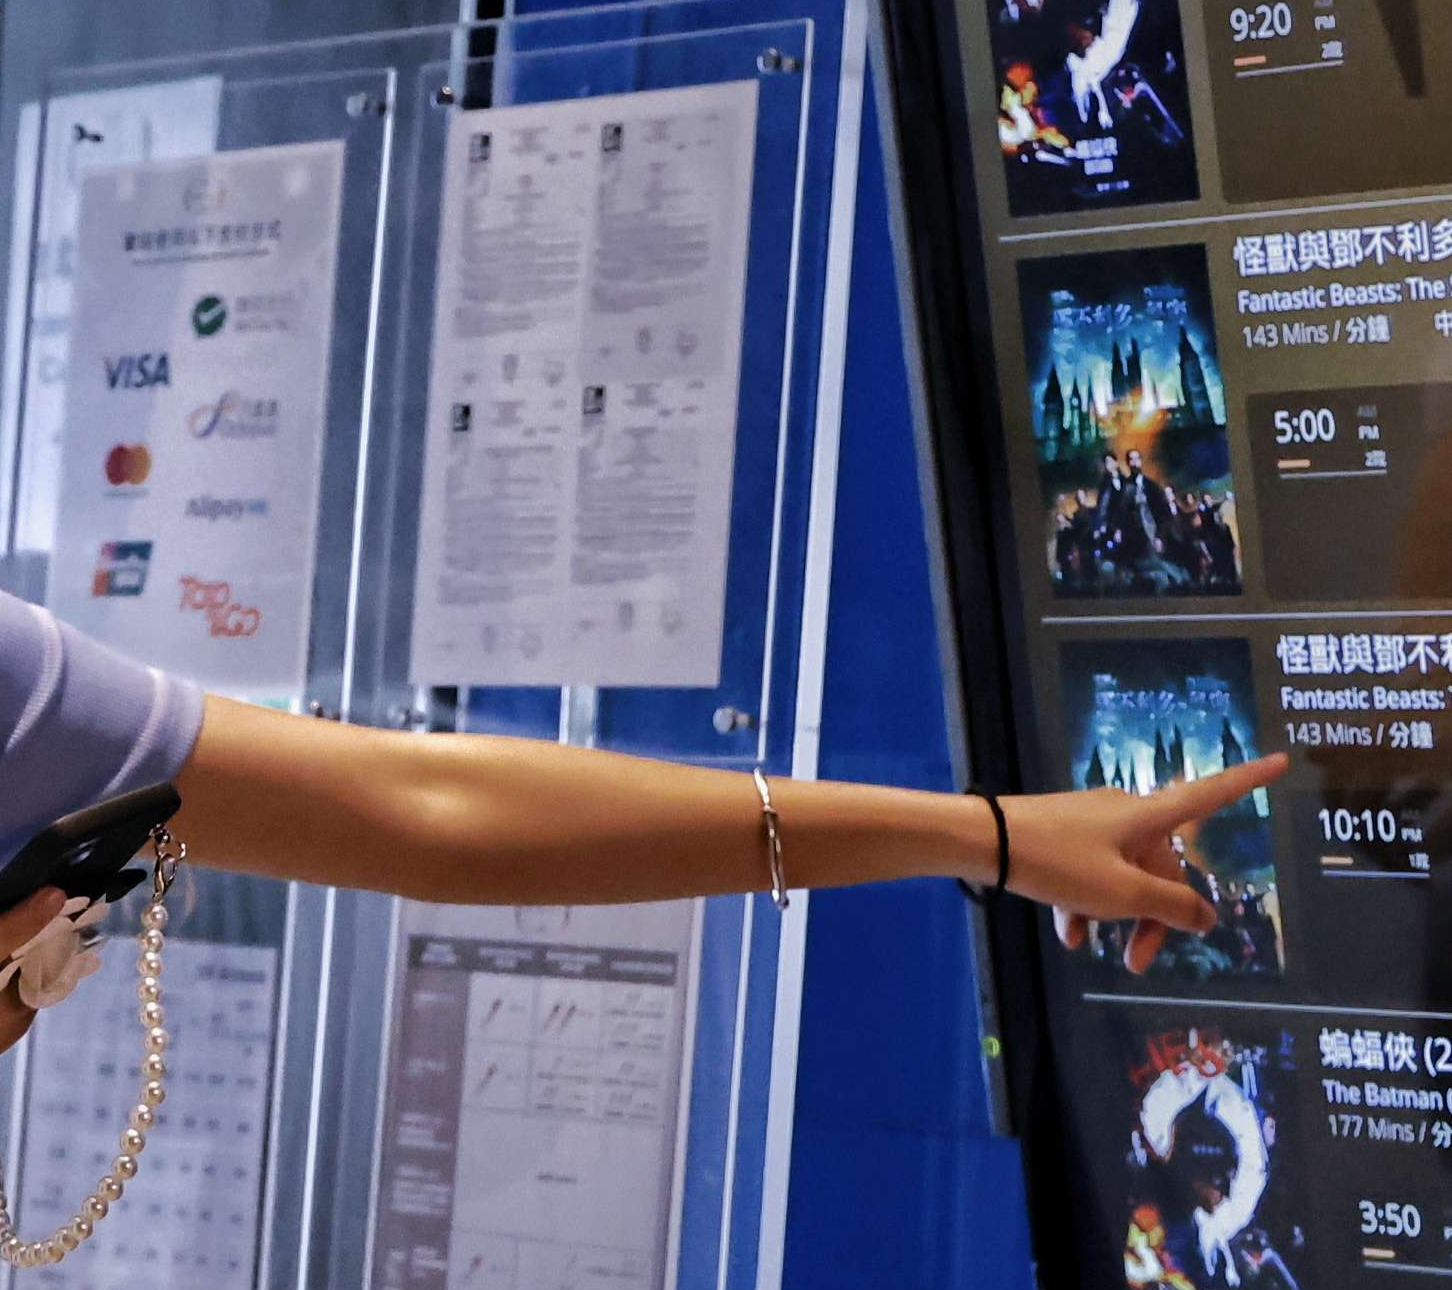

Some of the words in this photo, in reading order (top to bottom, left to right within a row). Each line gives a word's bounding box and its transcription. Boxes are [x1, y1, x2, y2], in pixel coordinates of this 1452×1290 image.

[1229, 1, 1293, 43] 9:20
[1237, 284, 1328, 315] Fantastic
[1329, 279, 1403, 309] Beasts:
[1404, 275, 1447, 302] The
[1241, 322, 1279, 350] 143
[1282, 320, 1330, 347] Mins
[103, 351, 171, 390] VISA
[1274, 408, 1336, 444] 5:00
[1280, 685, 1369, 710] Fantastic
[1372, 686, 1445, 710] Beasts:
[1284, 721, 1321, 746] 143
[1325, 721, 1372, 746] Mins
[1318, 808, 1397, 843] 10:10
[1318, 1027, 1418, 1074] 蝙蝠俠
[1321, 1079, 1362, 1106] The
[1365, 1081, 1443, 1111] Batman
[1327, 1113, 1362, 1139] 177
[1367, 1116, 1415, 1143] Mins
[1358, 1199, 1422, 1238] 3:50
